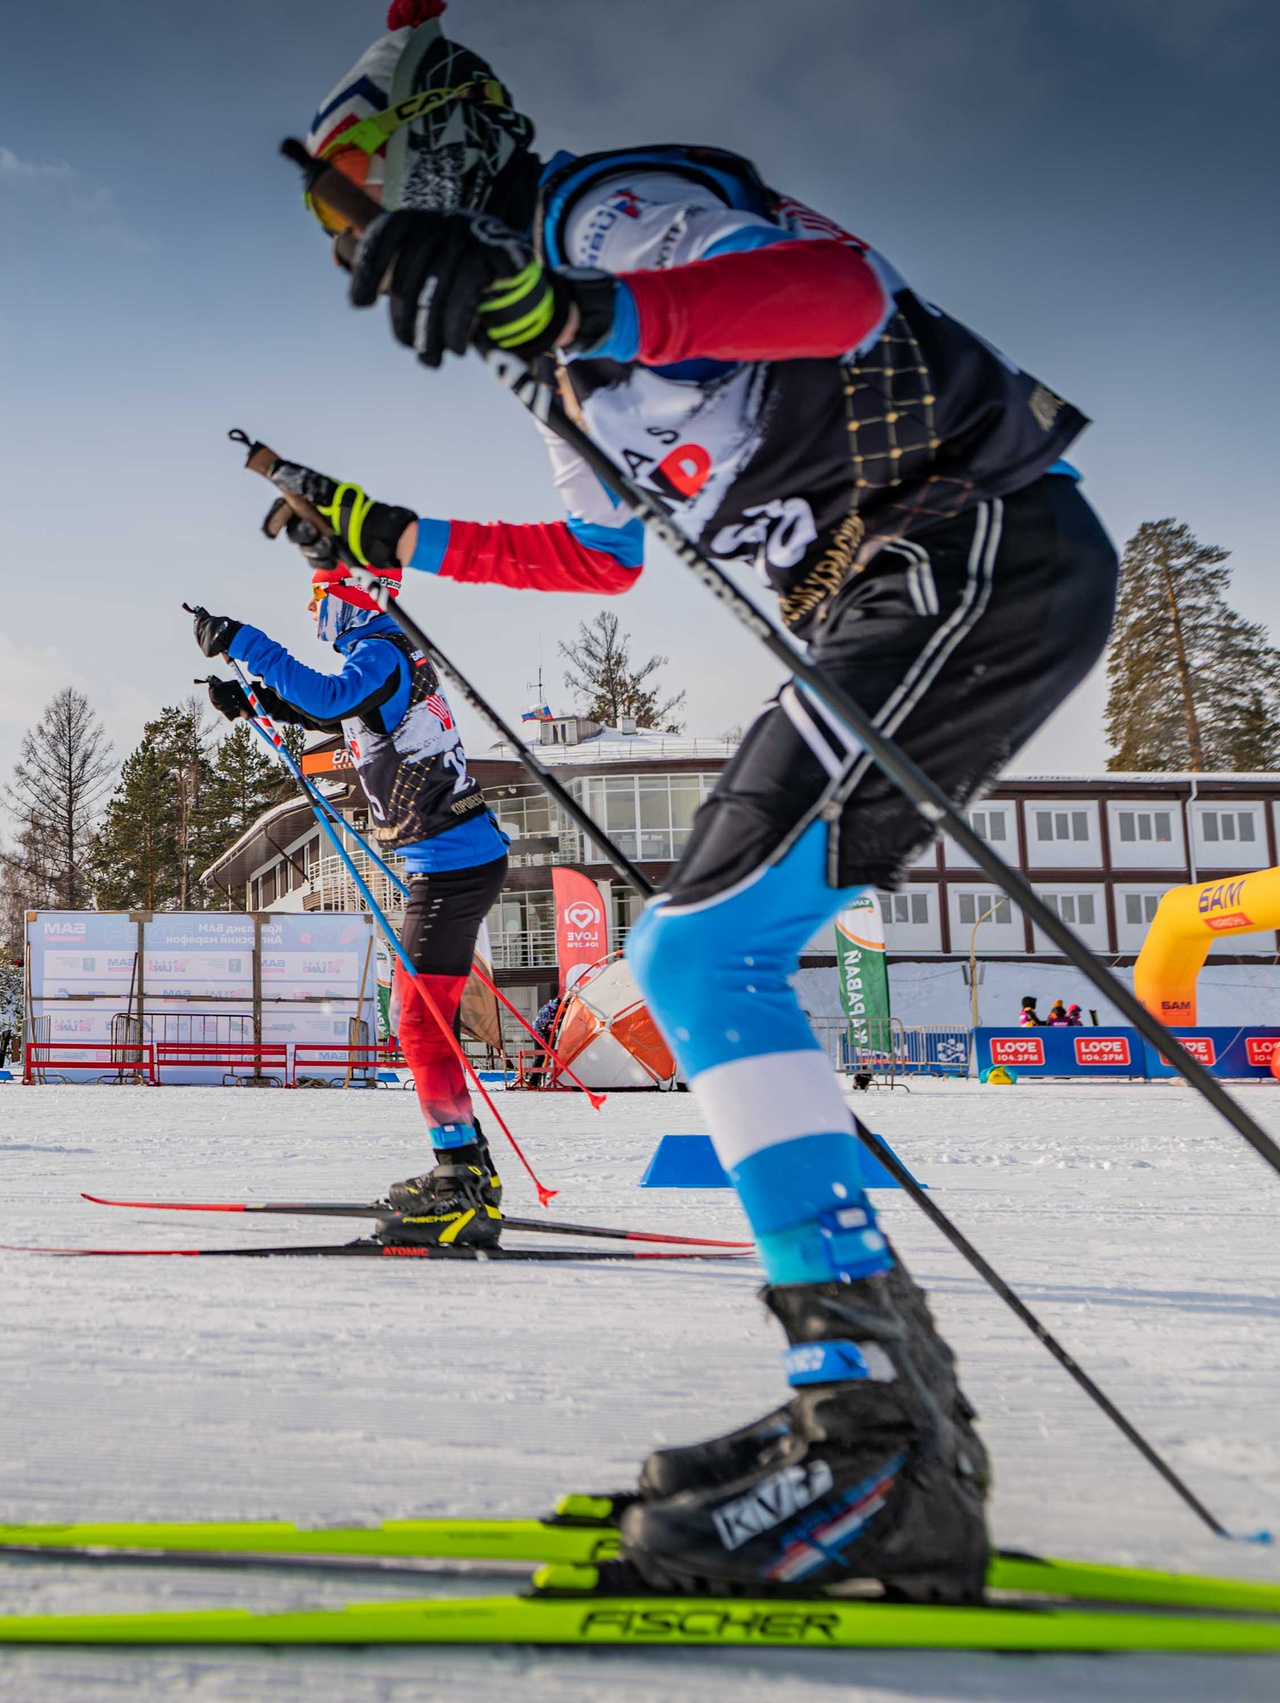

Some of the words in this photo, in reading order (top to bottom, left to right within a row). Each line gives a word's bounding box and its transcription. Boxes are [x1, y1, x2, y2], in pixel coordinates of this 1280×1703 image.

[1198, 879, 1247, 913] БАМ
[1161, 1002, 1191, 1010] БАМ
[997, 1054, 1038, 1062] 104.2FM
[1082, 1054, 1124, 1062] 104.2FM
[402, 1211, 463, 1224] FISCHER
[382, 1246, 429, 1257] ATOMIC
[579, 1610, 840, 1641] FISCHER
